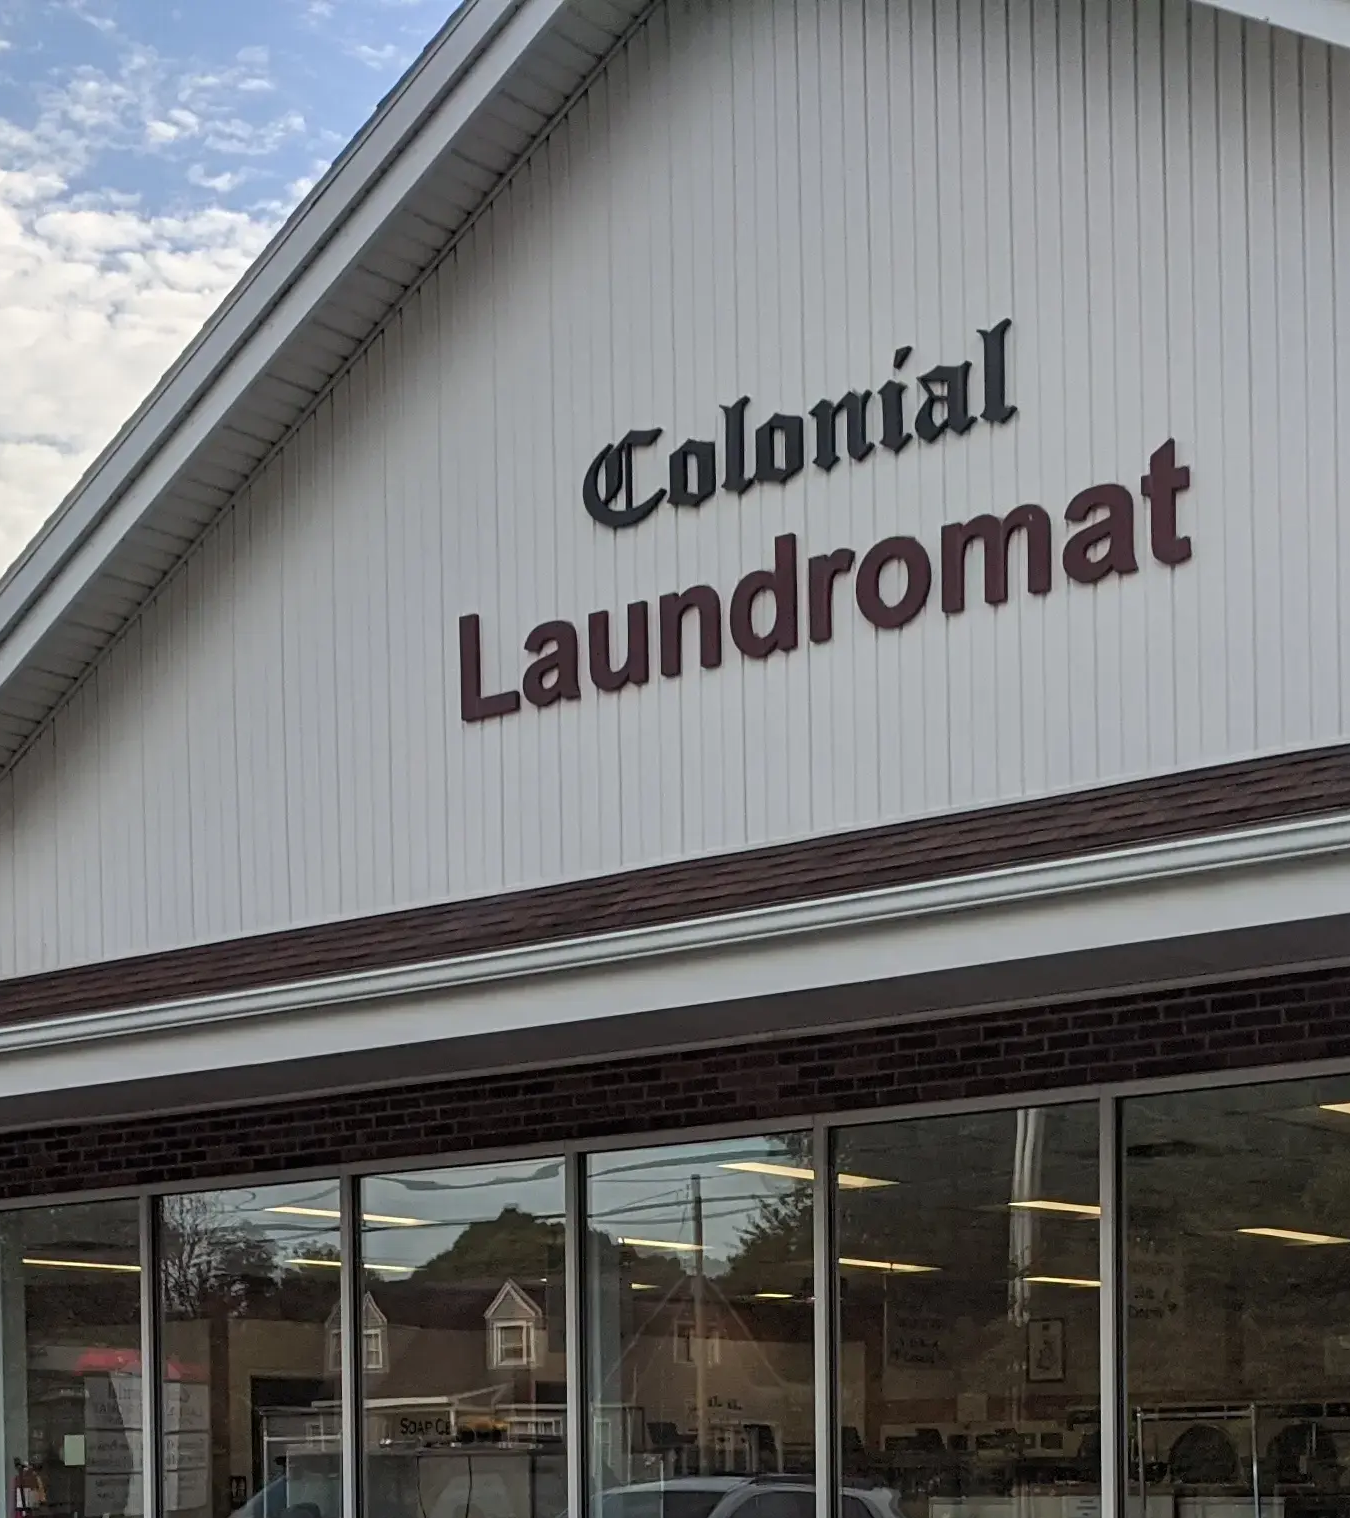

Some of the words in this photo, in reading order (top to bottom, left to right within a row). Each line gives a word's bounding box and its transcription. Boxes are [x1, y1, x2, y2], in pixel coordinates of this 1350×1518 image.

[582, 318, 1018, 529] Colonial
[459, 438, 1192, 722] Laundromat
[400, 1417, 433, 1435] SOAP
